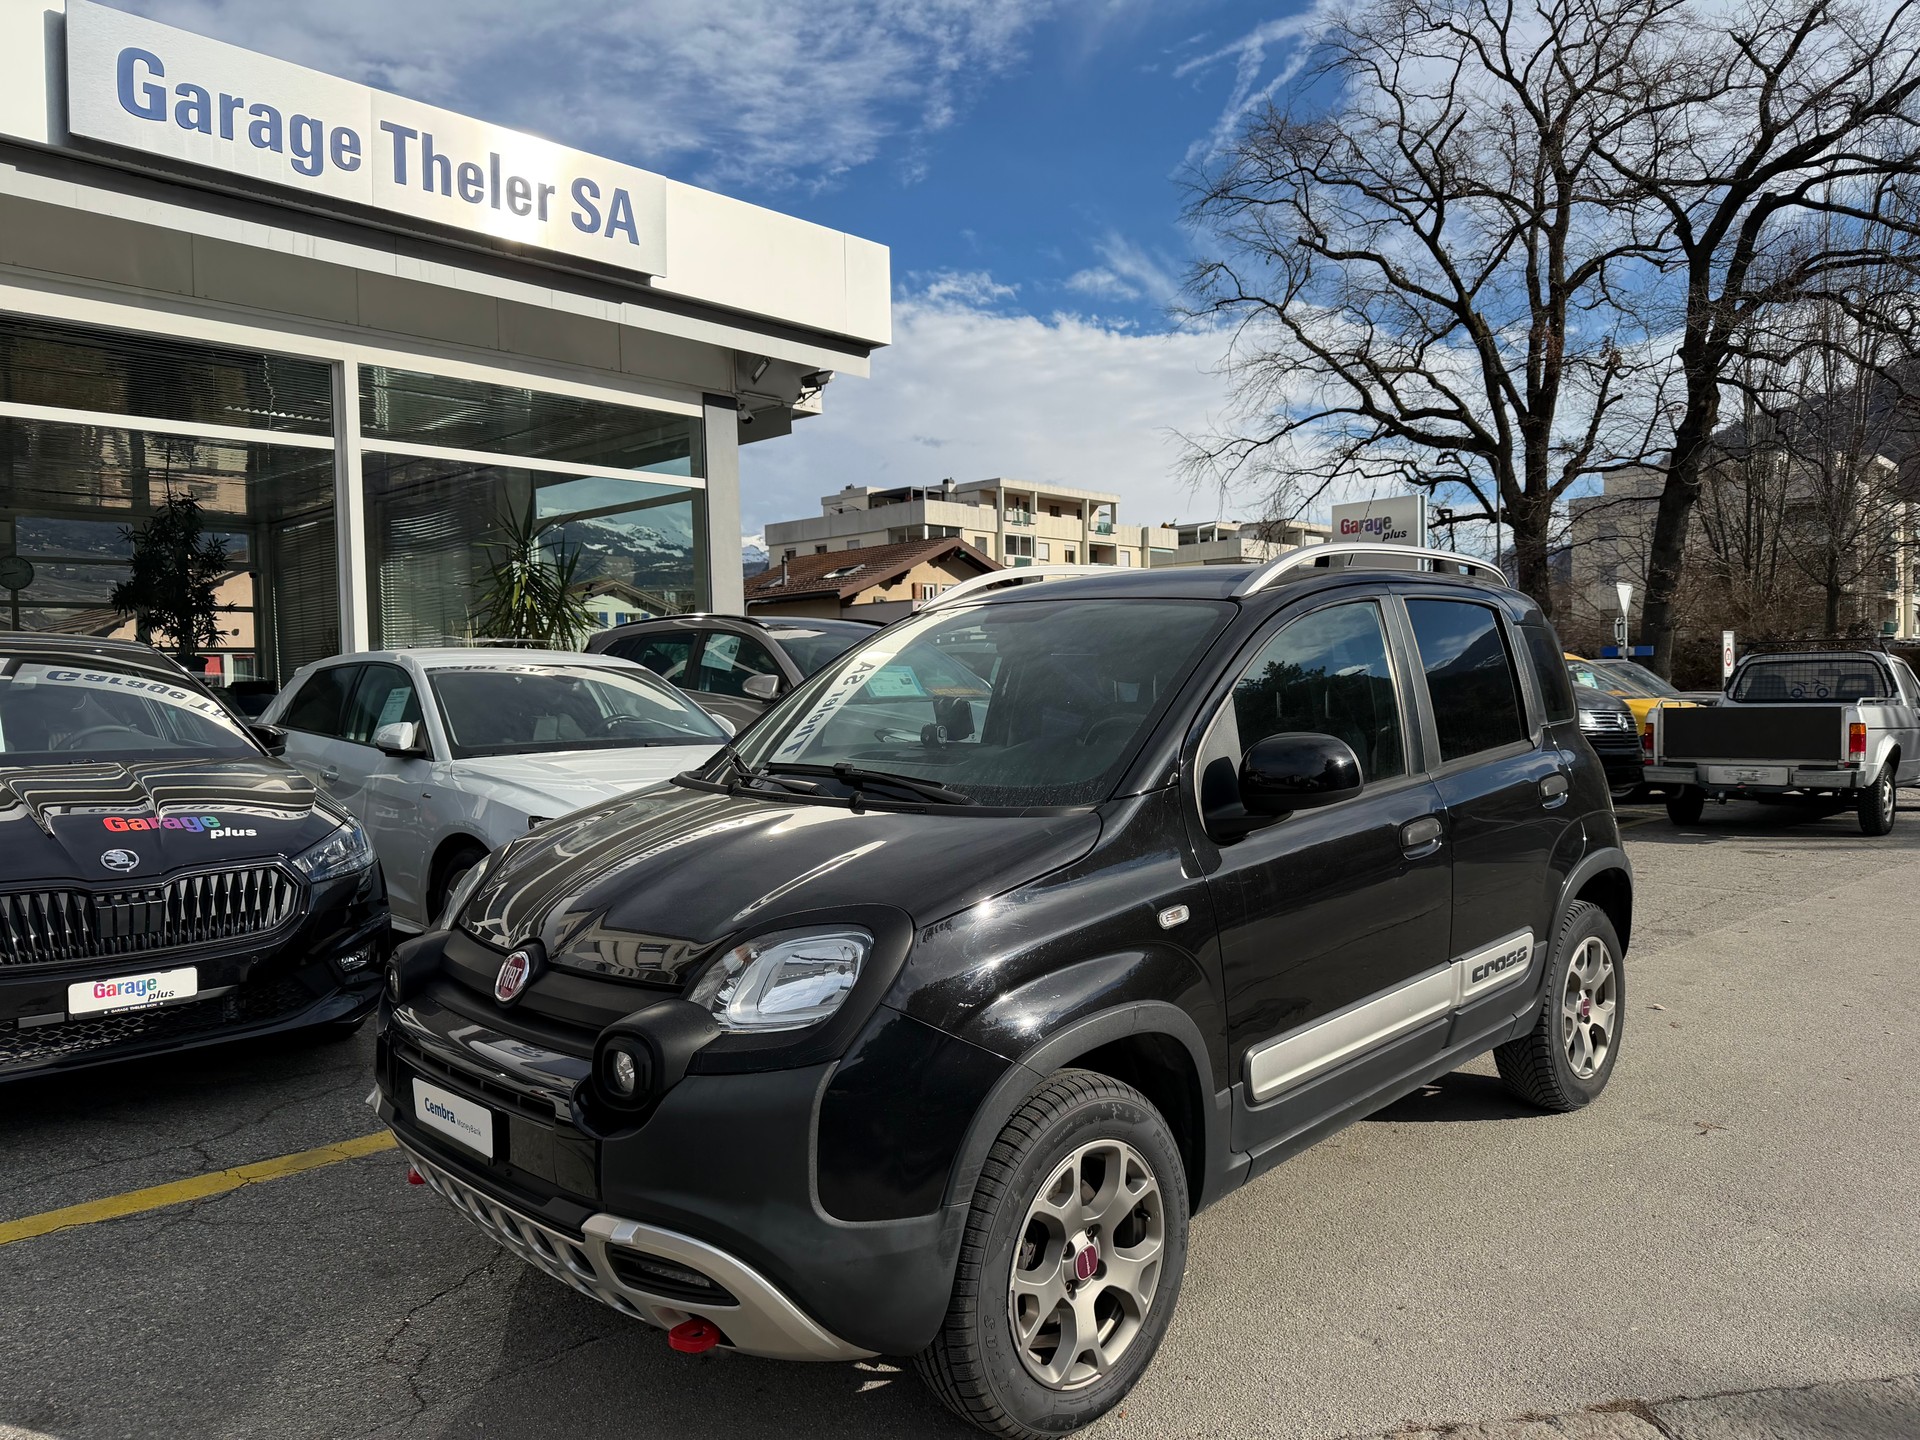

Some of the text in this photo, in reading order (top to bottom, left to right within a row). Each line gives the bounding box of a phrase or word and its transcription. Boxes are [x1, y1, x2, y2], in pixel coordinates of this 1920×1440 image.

[116, 46, 640, 246] Garage Theler SA
[1340, 516, 1392, 535] Garage
[1382, 529, 1407, 542] plus
[102, 815, 221, 833] Garage
[210, 827, 258, 839] plus
[500, 965, 523, 989] FIAT
[93, 978, 157, 998] Garage
[148, 989, 175, 1001] plus
[424, 1097, 456, 1124] Cembra
